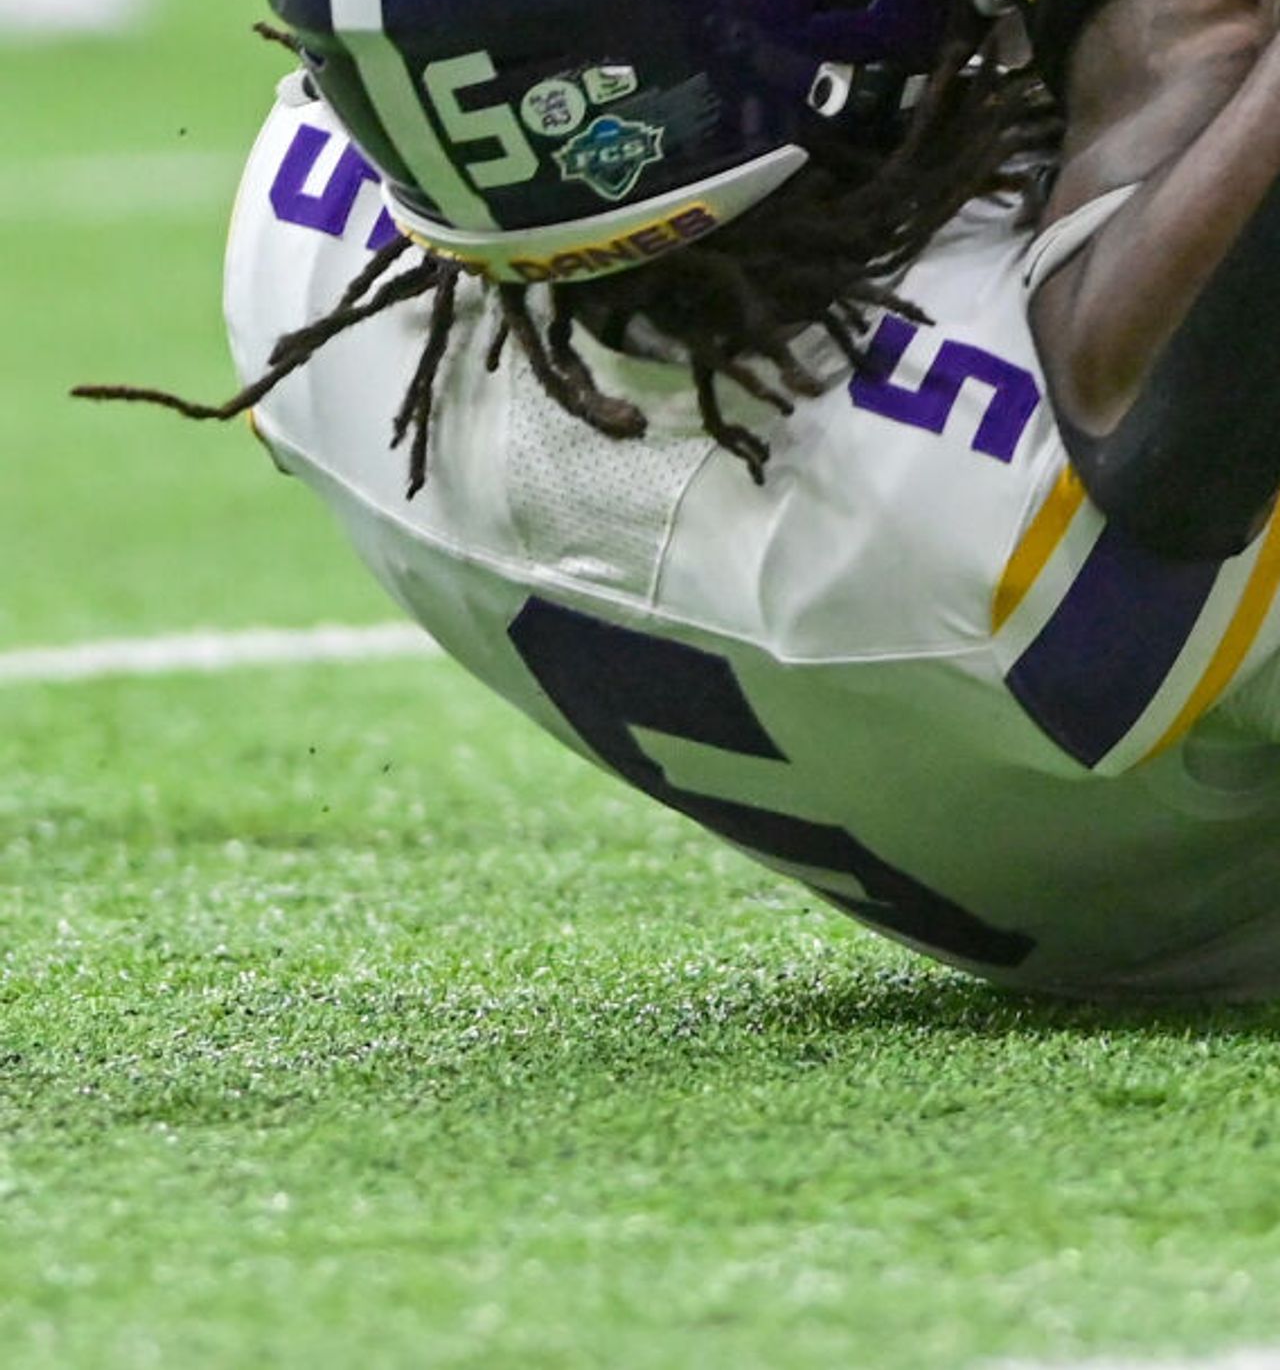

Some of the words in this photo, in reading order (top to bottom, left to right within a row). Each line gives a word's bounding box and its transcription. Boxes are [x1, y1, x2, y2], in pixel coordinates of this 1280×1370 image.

[423, 49, 540, 190] 5
[575, 139, 645, 169] FCS
[848, 312, 1041, 465] 5
